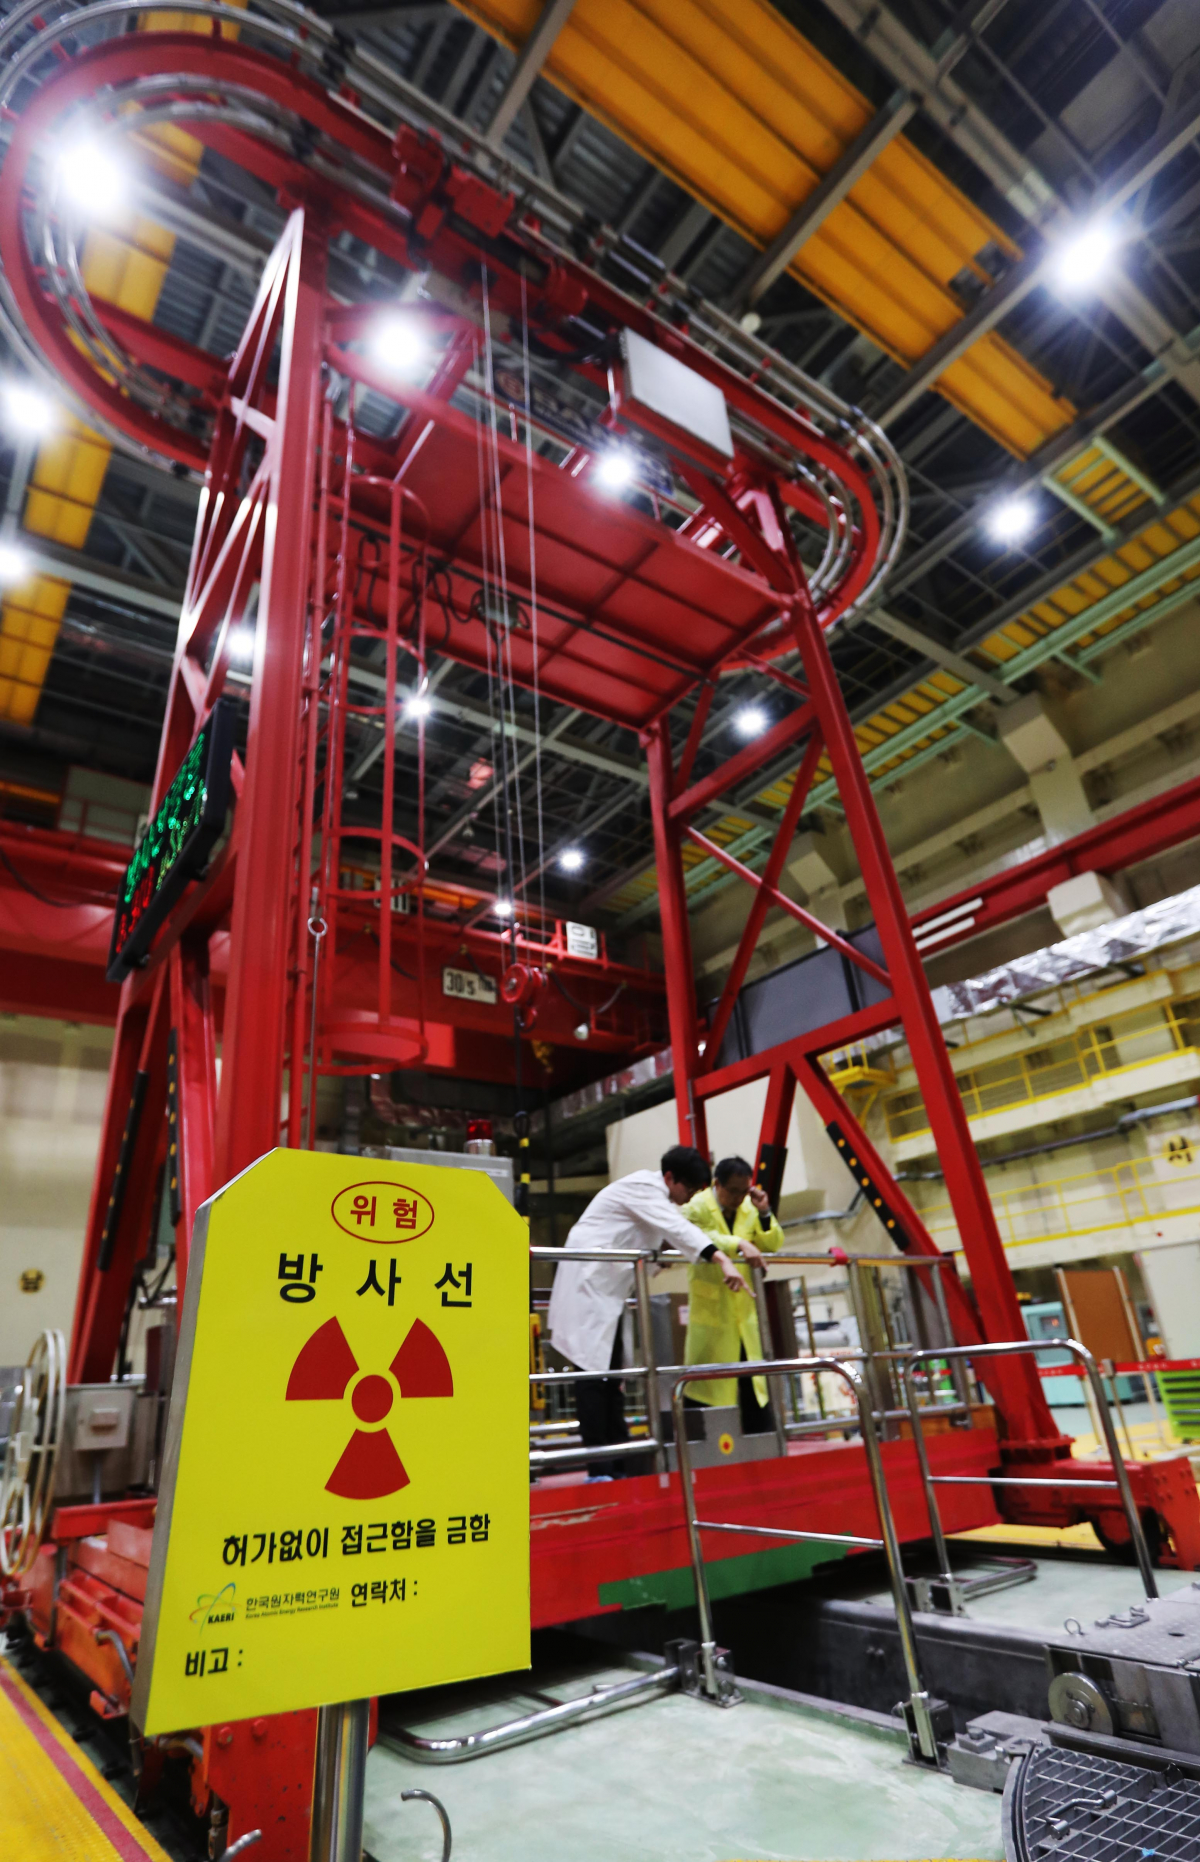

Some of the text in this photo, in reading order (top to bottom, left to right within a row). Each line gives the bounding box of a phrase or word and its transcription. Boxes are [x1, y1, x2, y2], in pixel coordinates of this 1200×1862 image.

[221, 1512, 492, 1567] 허가없이 접근함을 금함
[246, 1587, 340, 1611] 한국원자력연구원
[207, 1611, 236, 1625] KAERI
